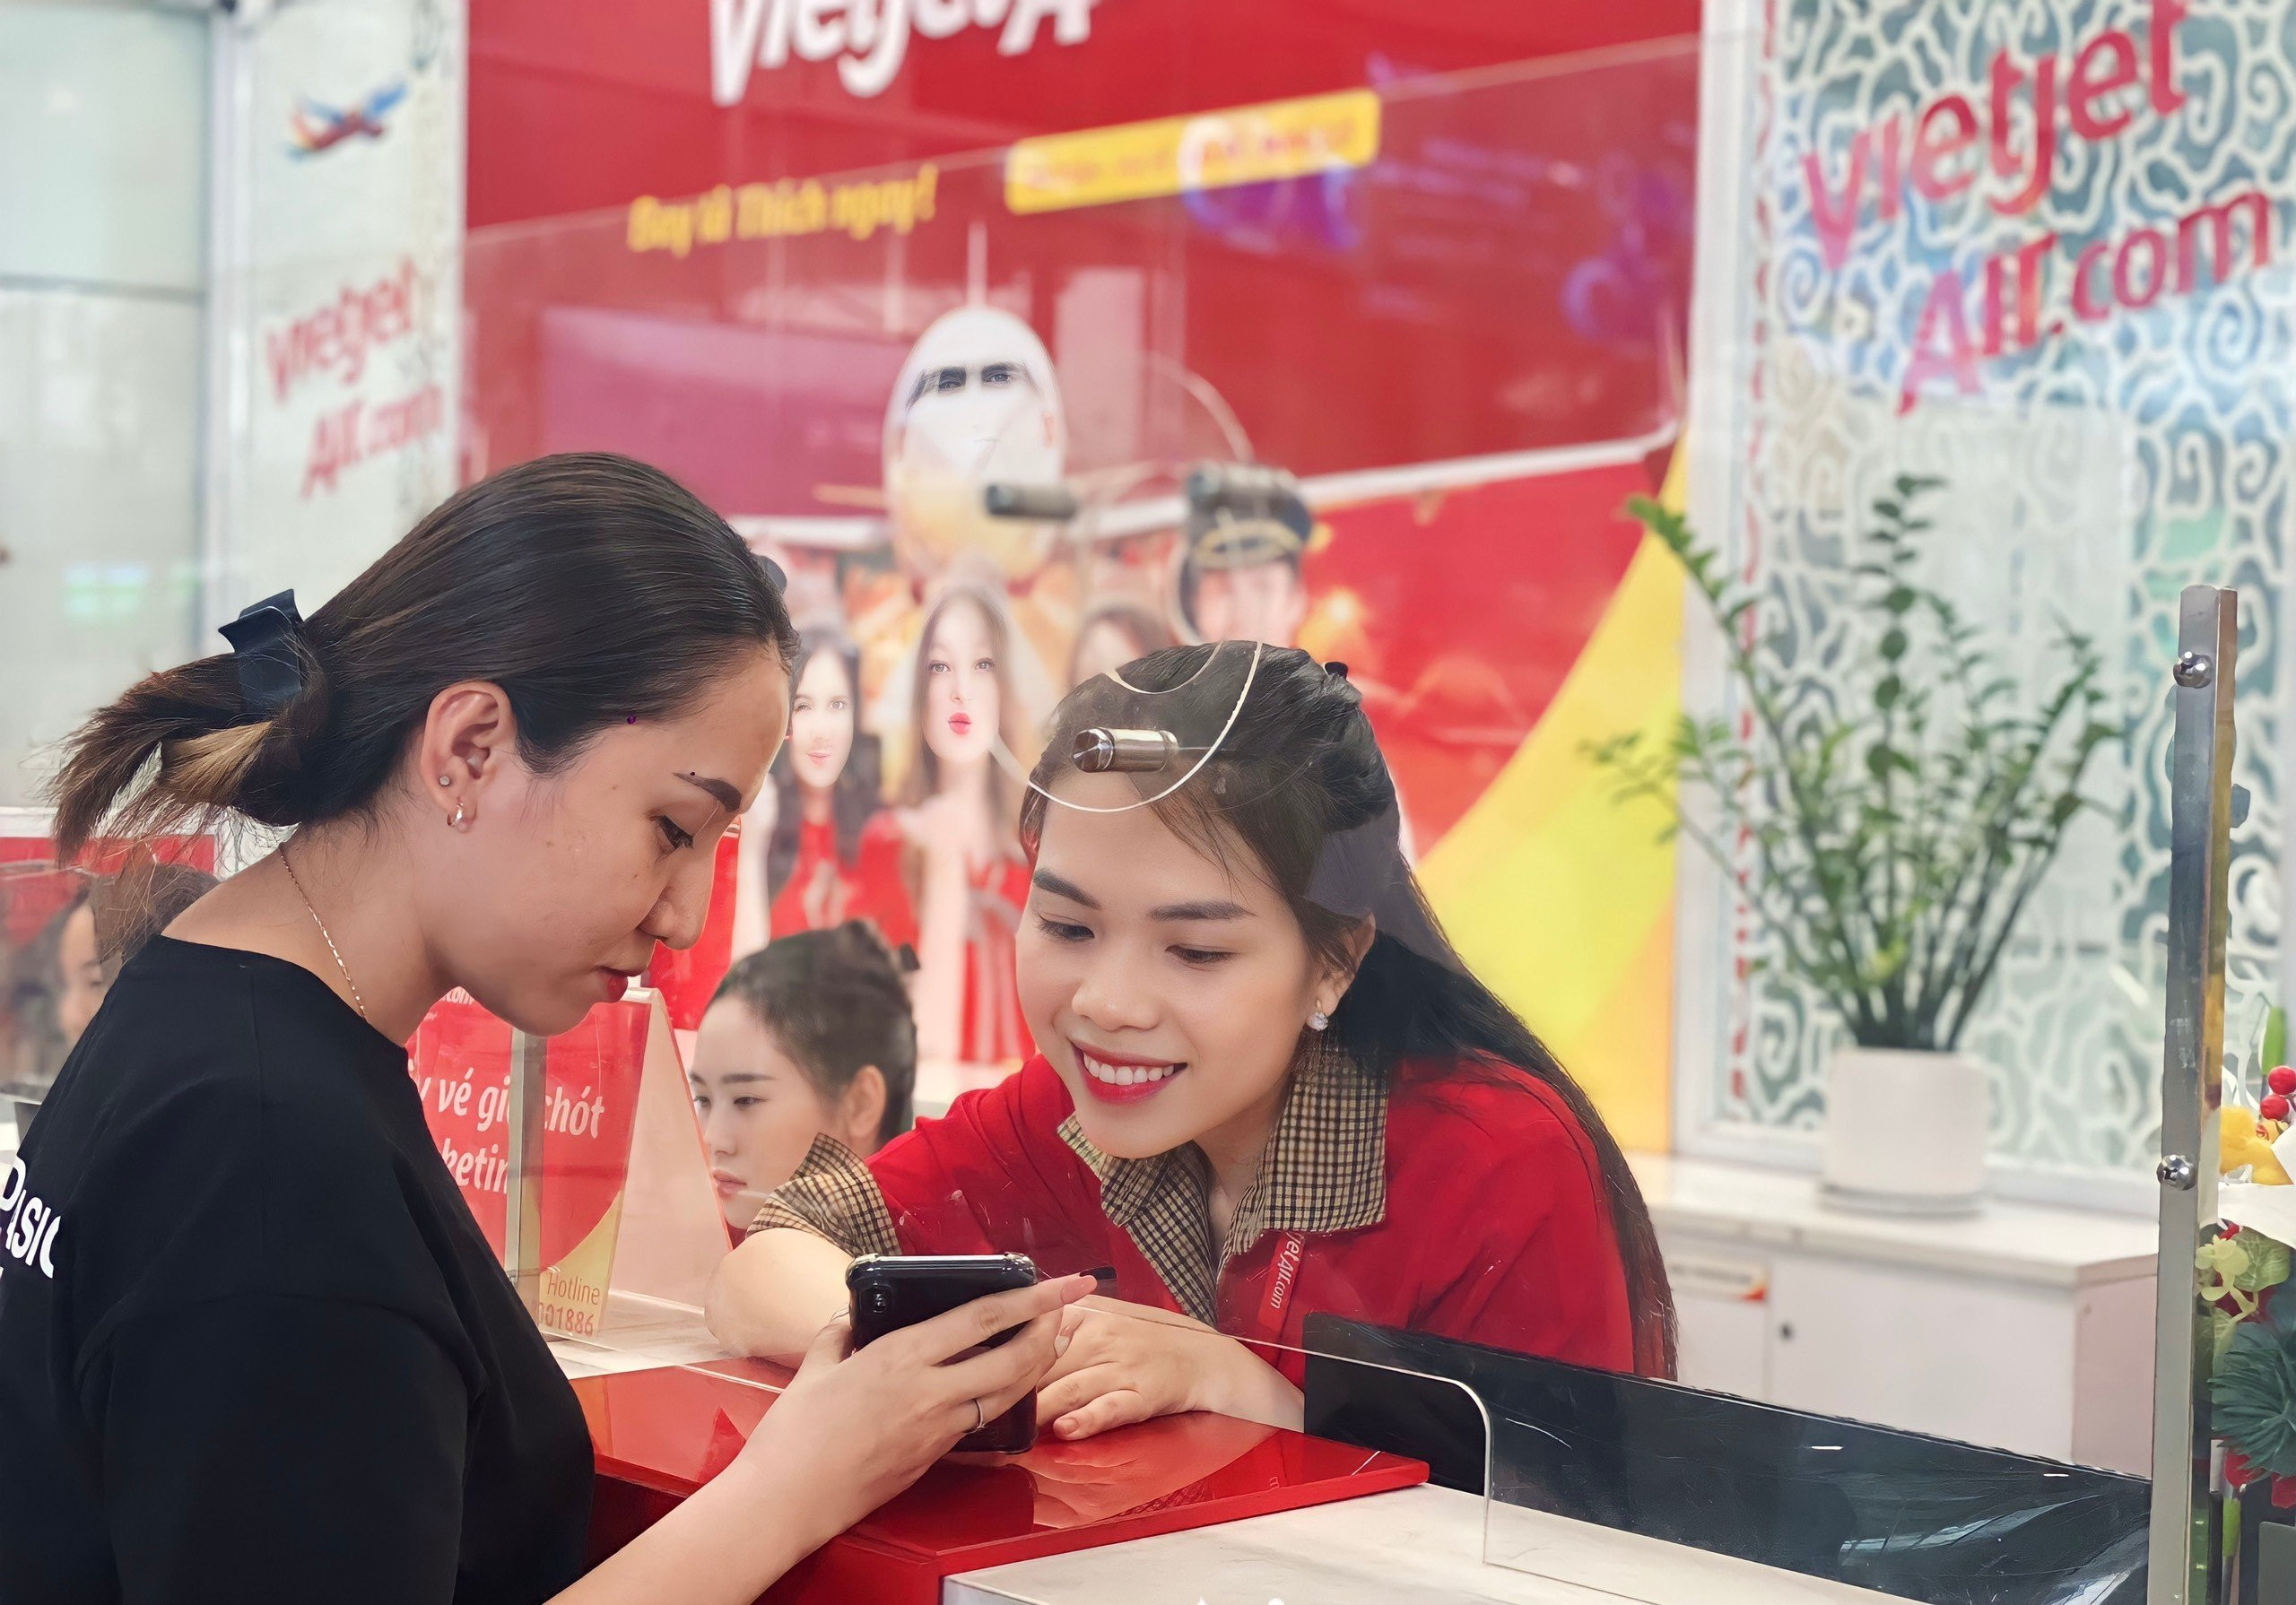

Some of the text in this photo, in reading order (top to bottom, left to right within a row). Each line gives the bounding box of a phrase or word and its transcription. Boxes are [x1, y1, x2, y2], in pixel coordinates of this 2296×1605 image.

[439, 1067, 474, 1115] vé
[477, 1075, 510, 1132] gi
[548, 1272, 600, 1306] Hotline
